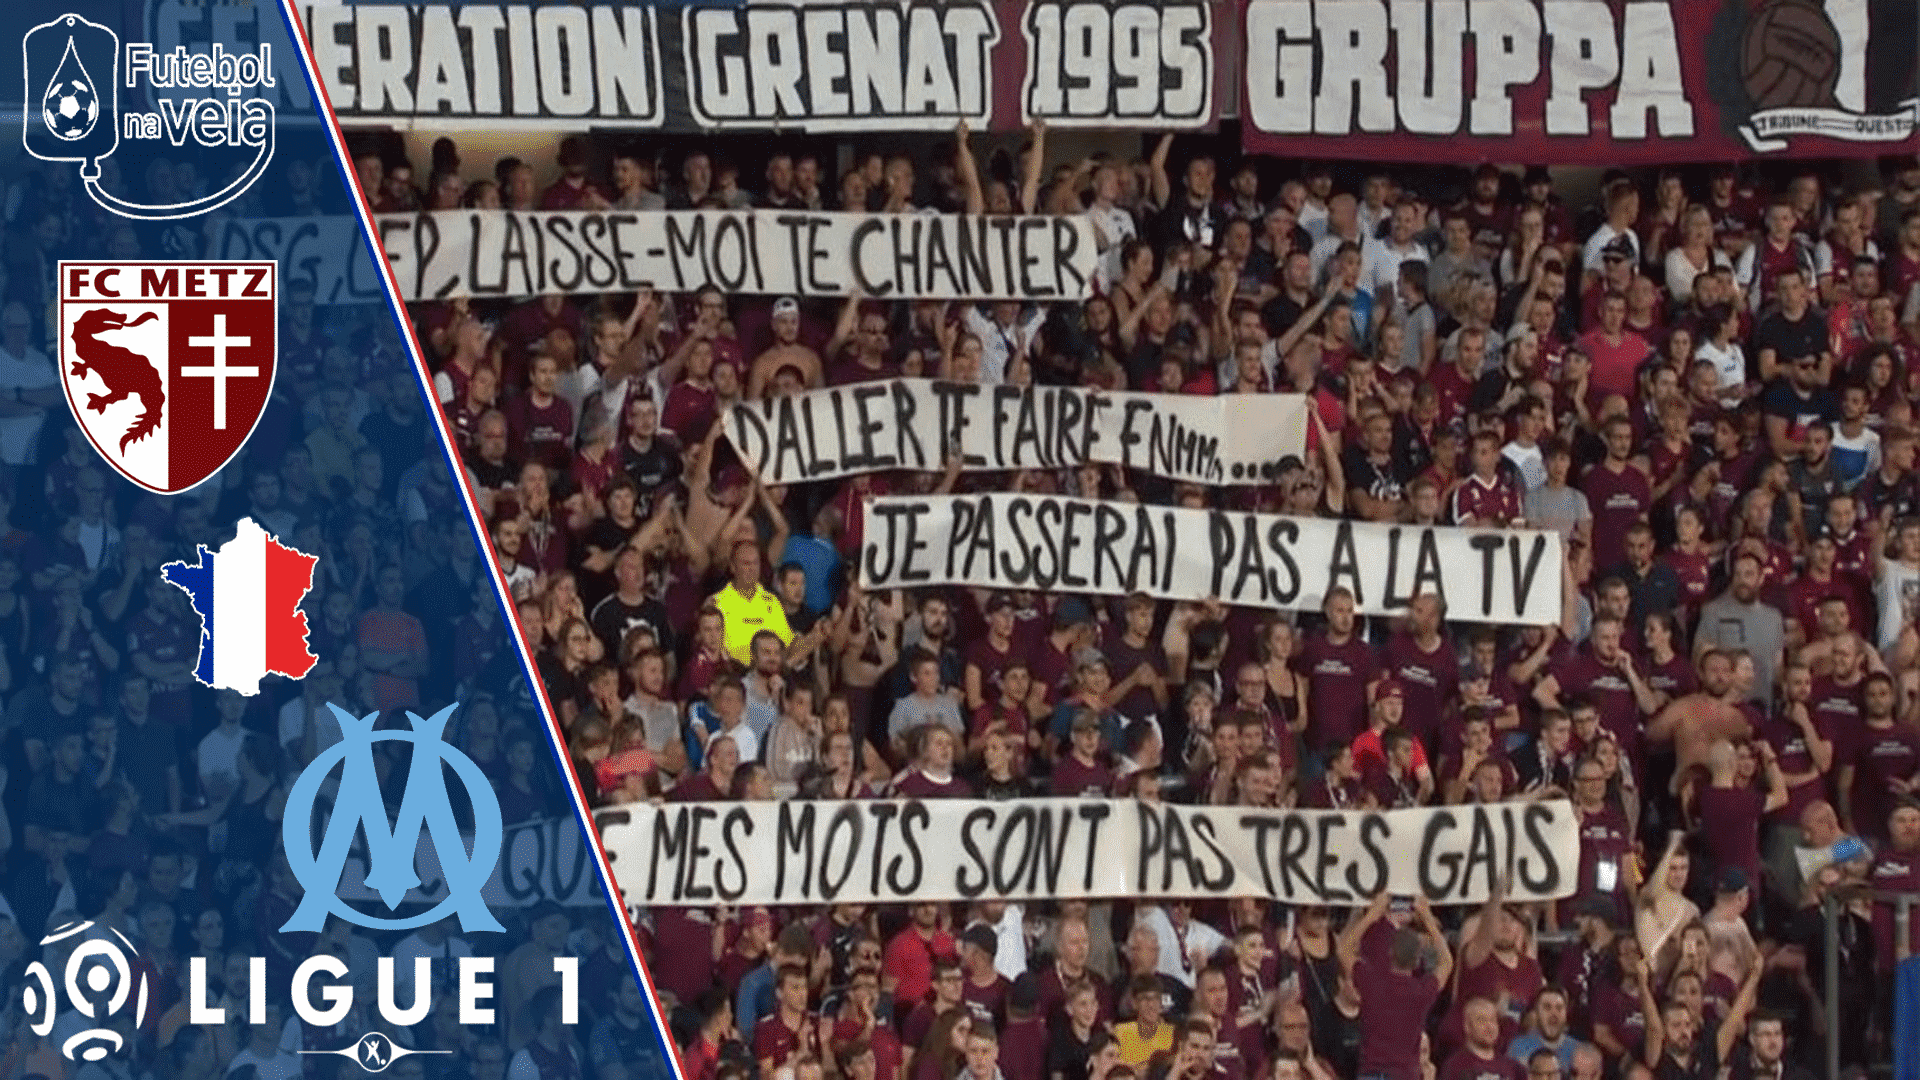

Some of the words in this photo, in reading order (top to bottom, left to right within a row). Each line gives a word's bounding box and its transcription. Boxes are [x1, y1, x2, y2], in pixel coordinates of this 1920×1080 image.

[696, 8, 989, 117] GRENAT
[1031, 4, 1205, 116] 1995
[1247, 0, 1694, 138] GRUPPA
[469, 213, 764, 298] LAISSE-MOI
[777, 215, 841, 297] TE
[850, 214, 1086, 297] CHANTER
[733, 380, 925, 481] D'ALLER
[931, 380, 987, 468] TE
[865, 503, 931, 585] JE
[945, 496, 1177, 592] PASSERAI
[1208, 510, 1301, 604] PAS
[1326, 518, 1364, 605] A
[1382, 526, 1448, 610] LA
[1468, 533, 1547, 617] TV
[645, 805, 755, 901] MES
[773, 801, 930, 900] MOTS
[954, 804, 1111, 898] SONT
[1137, 801, 1235, 893] PAS
[1239, 813, 1391, 902] TRES
[1417, 804, 1560, 902] GAIS
